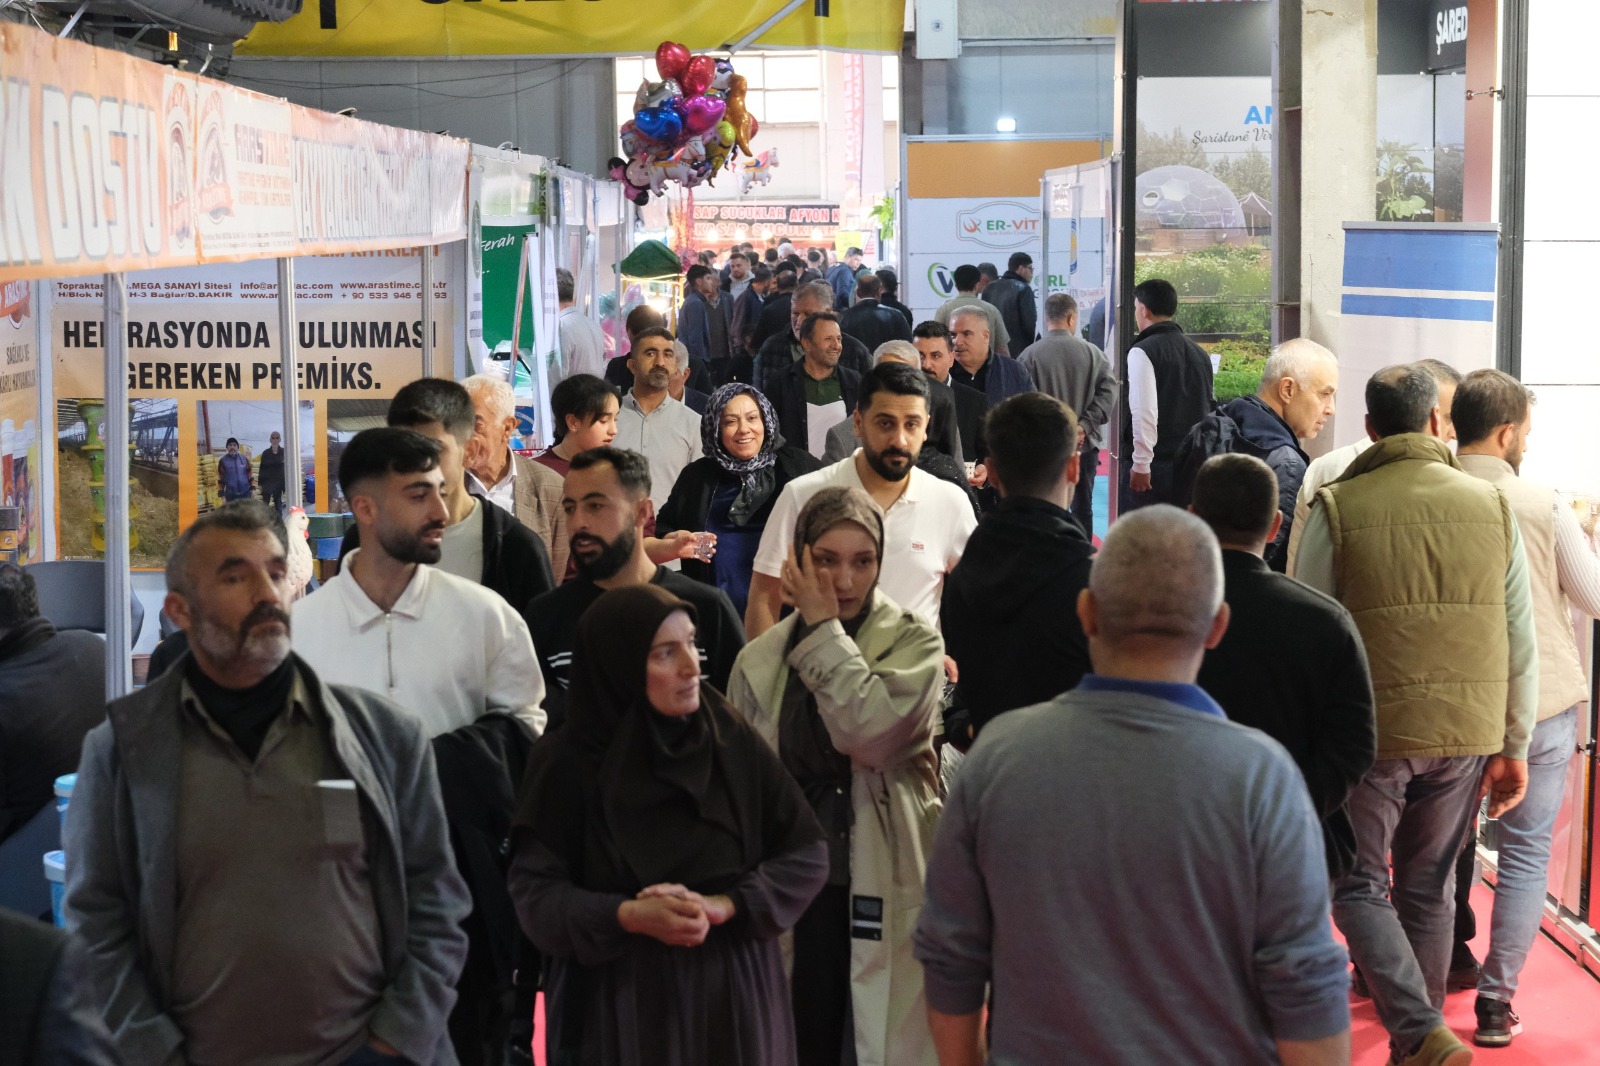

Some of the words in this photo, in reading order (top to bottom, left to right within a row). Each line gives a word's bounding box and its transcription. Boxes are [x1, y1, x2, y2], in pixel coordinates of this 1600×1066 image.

[41, 83, 161, 263] DOSTU
[720, 206, 787, 220] SUCUKLAR
[788, 208, 830, 223] AFYON
[204, 282, 232, 290] Sitesi
[63, 321, 104, 348] HE
